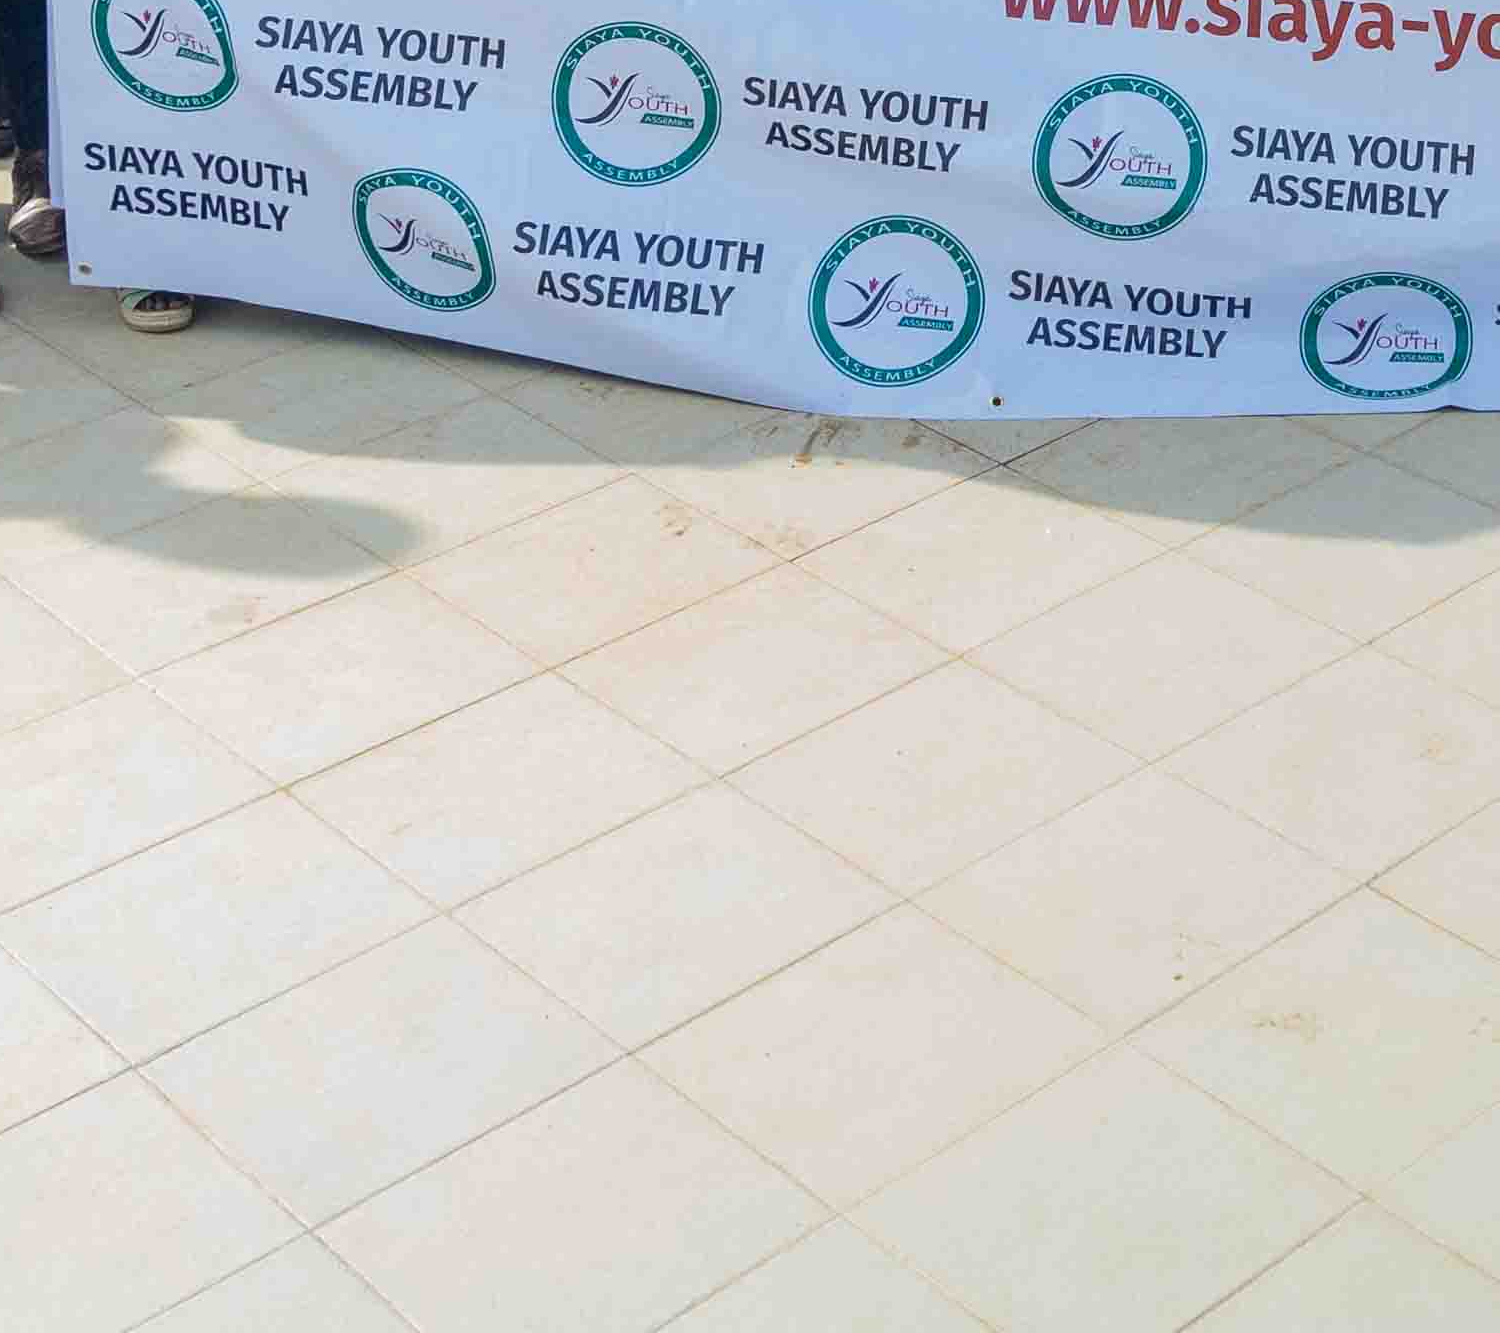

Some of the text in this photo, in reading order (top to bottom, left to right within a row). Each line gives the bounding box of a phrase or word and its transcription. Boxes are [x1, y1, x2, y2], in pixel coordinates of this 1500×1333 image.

[255, 16, 506, 70] SIAYA YOUTH
[565, 28, 711, 90] SIAYA YOUTH
[274, 64, 478, 111] ASSEMBLY
[743, 76, 989, 131] SIAYA YOUTH
[1048, 80, 1199, 144] SIAYA YOUTH
[84, 142, 309, 197] SIAYA YOUTH
[581, 151, 682, 180] ASSEMBLY
[765, 121, 961, 173] ASSEMBLY
[1230, 125, 1475, 176] SIAYA YOUTH
[110, 184, 290, 232] ASSEMBLY
[409, 175, 482, 239] YOUTH
[1066, 206, 1163, 234] ASSEMBLY
[1249, 173, 1450, 219] ASSEMBLY
[513, 221, 765, 274] SIAYA YOUTH
[824, 221, 977, 287] SIAYA YOUTH
[537, 270, 736, 316] ASSEMBLY
[1008, 269, 1252, 319] SIAYA YOUTH
[1313, 275, 1463, 318] SIAYA YOUTH
[1026, 316, 1228, 359] ASSEMBLY
[837, 353, 938, 381] ASSEMBLY
